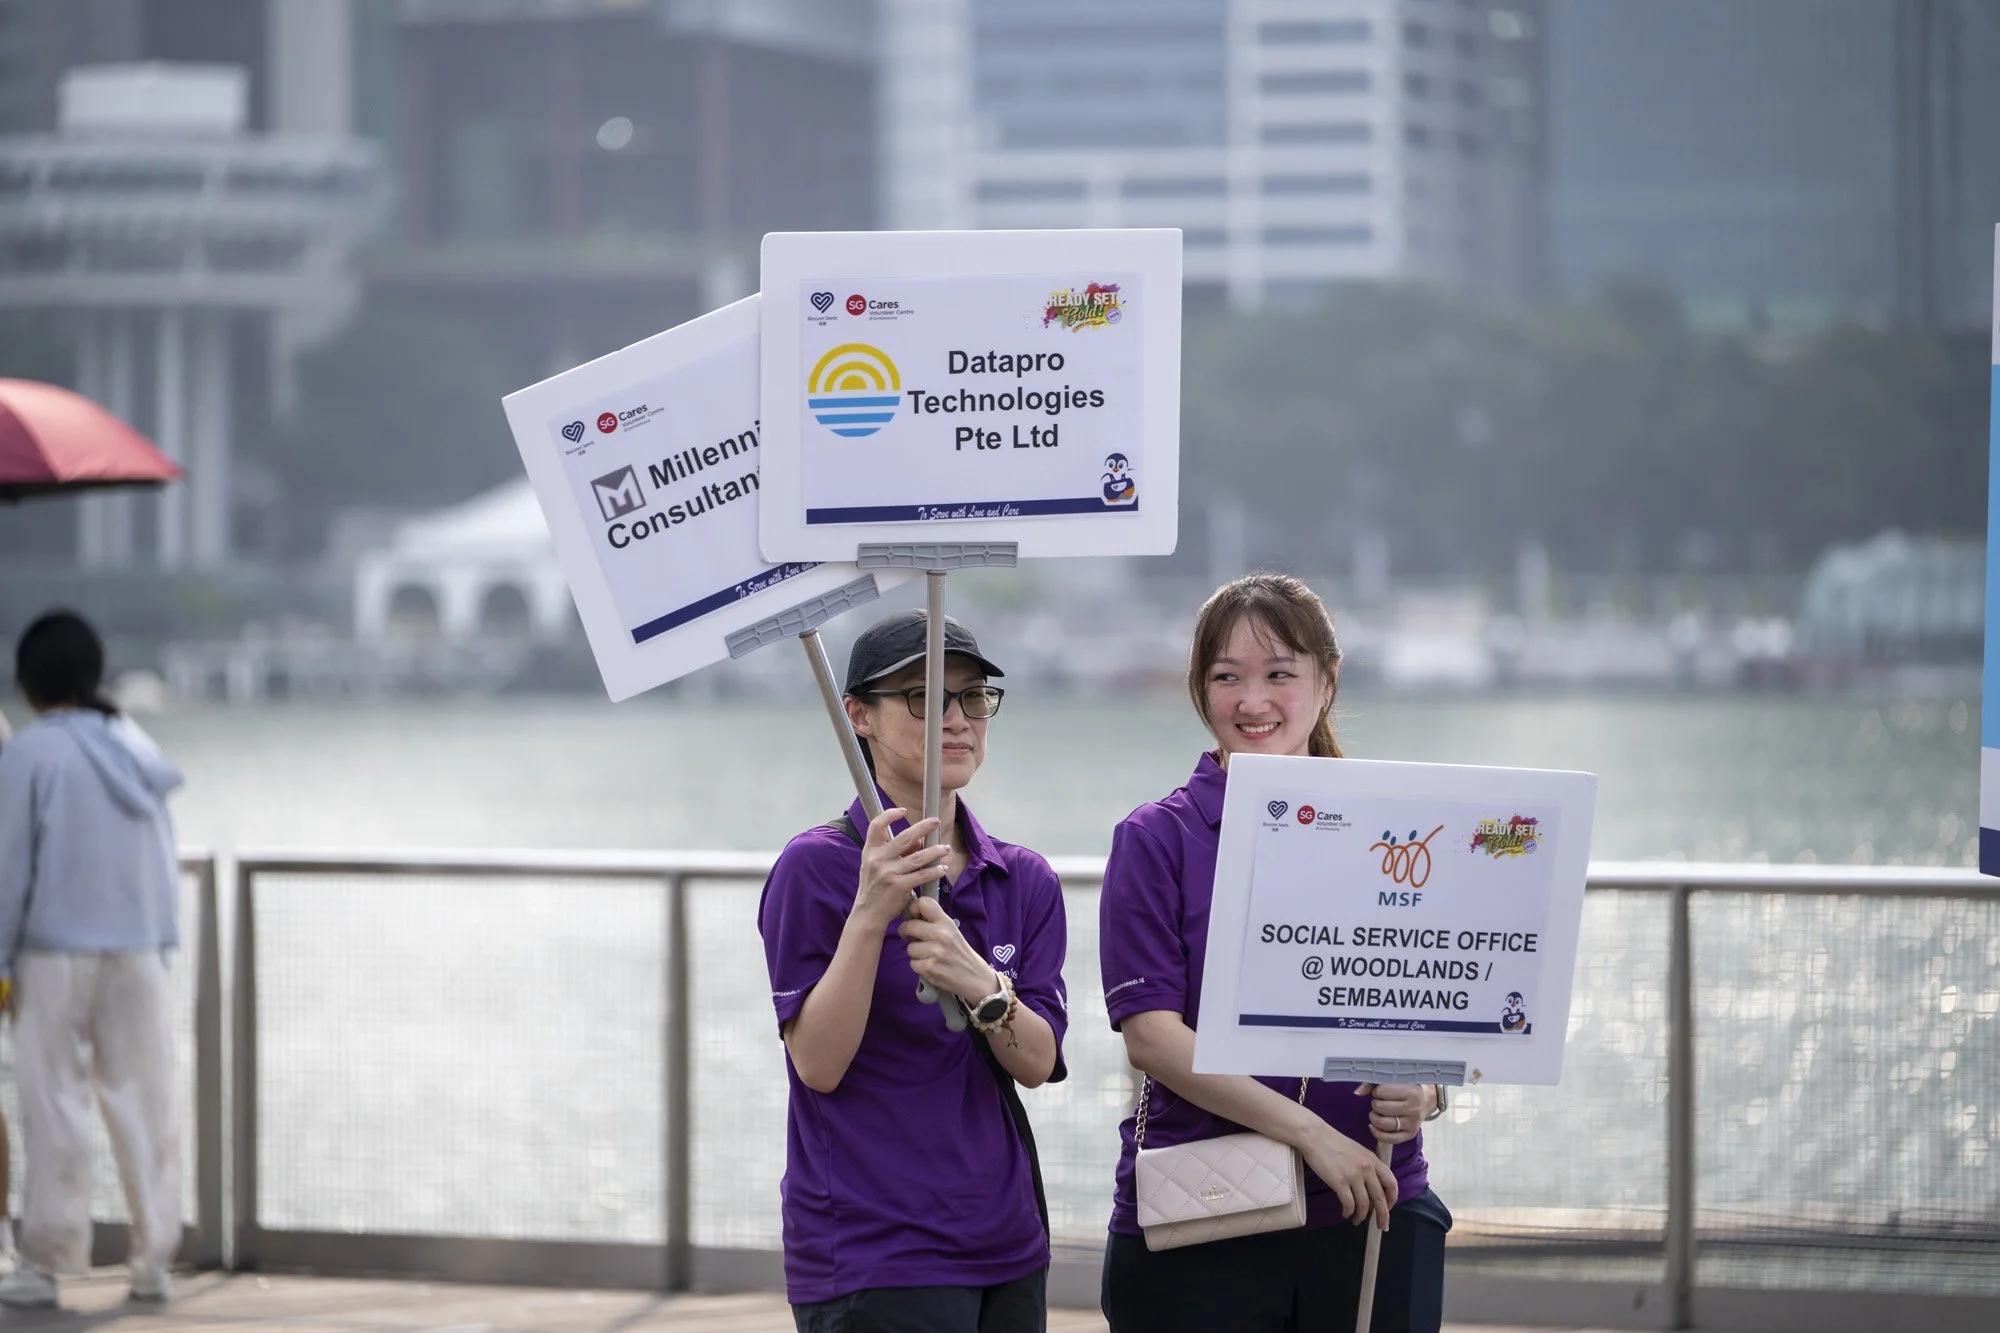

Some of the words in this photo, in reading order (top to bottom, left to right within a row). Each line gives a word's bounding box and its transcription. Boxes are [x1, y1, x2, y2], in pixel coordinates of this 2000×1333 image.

[848, 301, 864, 310] SG
[868, 300, 899, 309] Cares
[1049, 292, 1090, 306] READY
[1093, 291, 1117, 305] SET
[1062, 304, 1104, 327] Gold!
[948, 350, 1065, 377] Datapro
[907, 385, 1105, 415] Technologies
[618, 404, 648, 421] Cares
[599, 417, 616, 430] SG
[955, 426, 1002, 451] Pte
[1013, 423, 1059, 449] Ltd
[607, 465, 760, 549] Consultan
[917, 507, 928, 520] To
[951, 505, 967, 518] with
[968, 505, 985, 518] Love
[986, 505, 1001, 516] and
[735, 585, 747, 599] To
[1299, 810, 1313, 820] SG
[1316, 811, 1343, 821] Cares
[1478, 823, 1513, 835] READY
[1515, 824, 1535, 836] SET
[1377, 891, 1422, 907] MSF
[1260, 924, 1345, 946] SOCIAL
[1351, 926, 1450, 950] SERVICE
[1457, 930, 1538, 953] OFFICE
[1301, 956, 1324, 980] @
[1331, 956, 1479, 981] WOODLANDS
[1484, 961, 1493, 981] /
[1317, 986, 1469, 1011] SEMBAWANG
[1338, 1018, 1347, 1027] To
